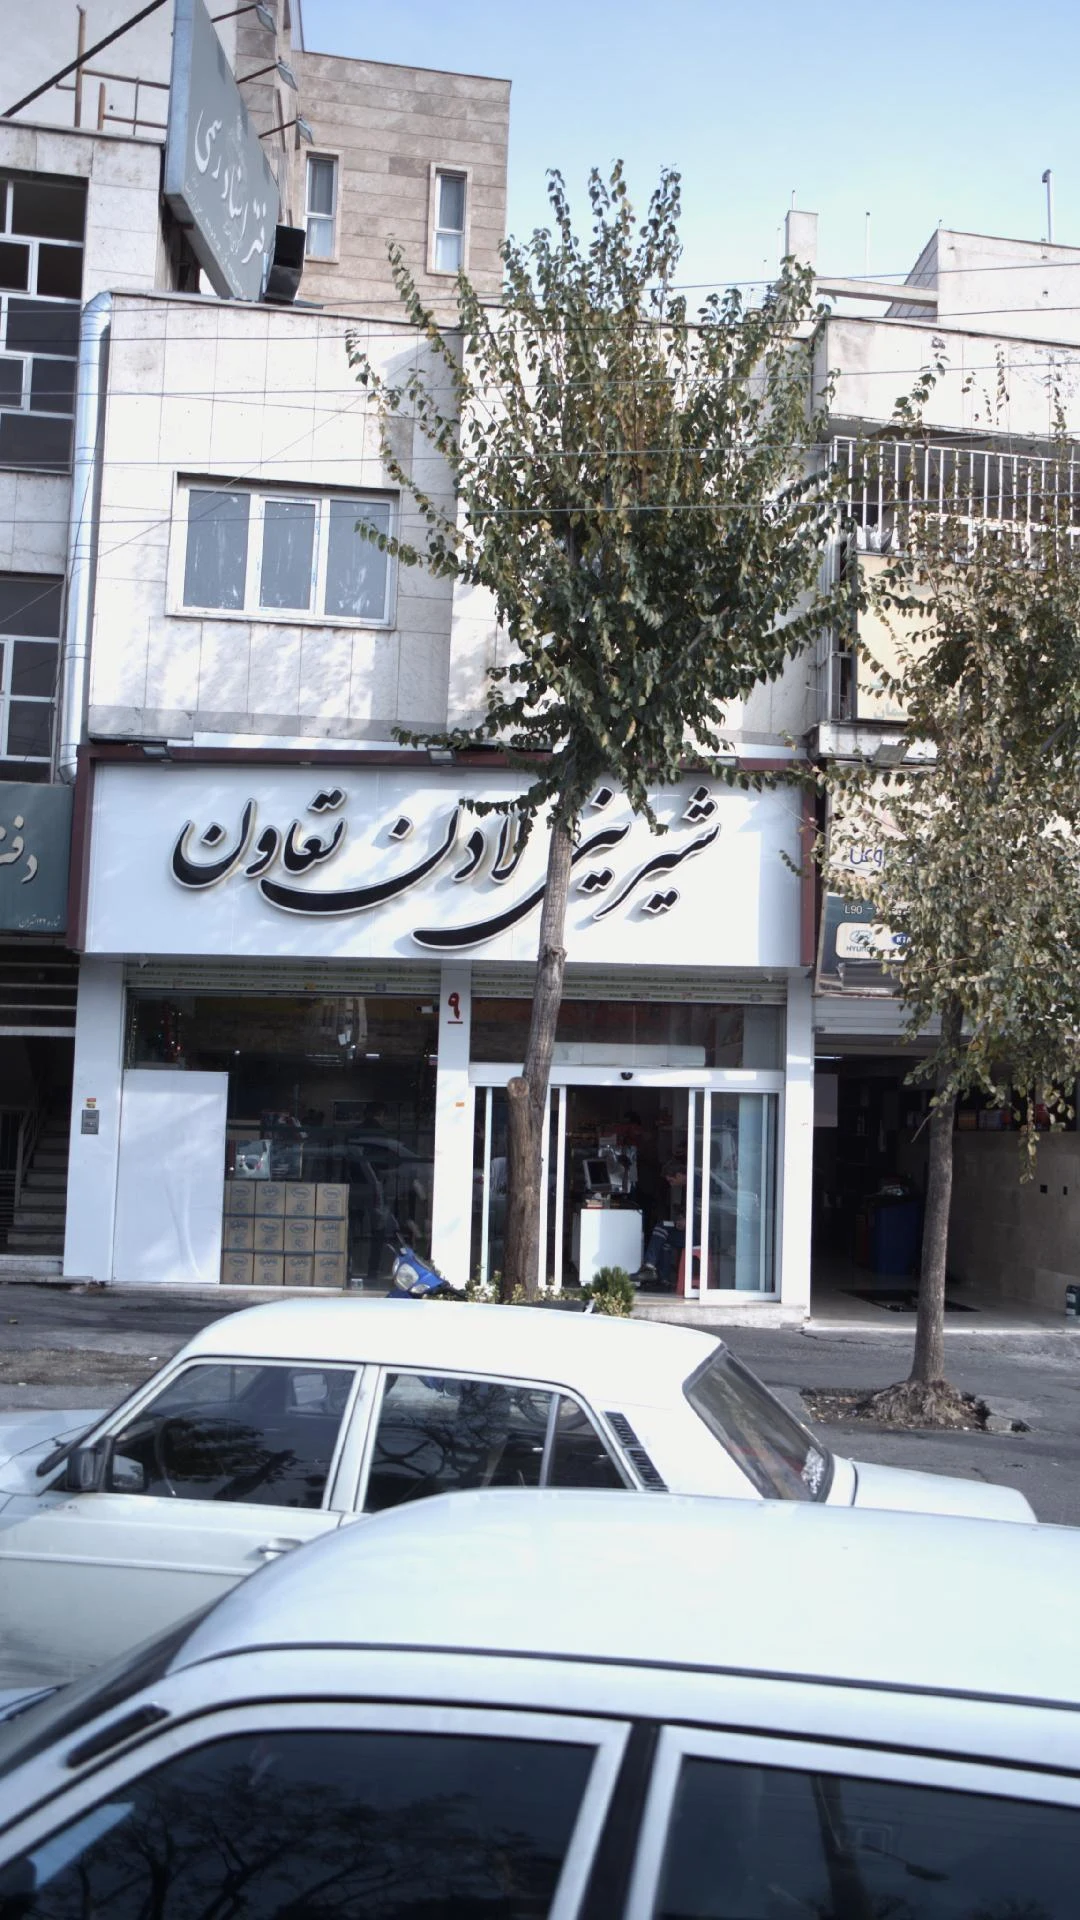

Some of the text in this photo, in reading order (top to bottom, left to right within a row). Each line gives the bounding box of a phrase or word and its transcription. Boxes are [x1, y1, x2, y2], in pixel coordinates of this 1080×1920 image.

[194, 110, 223, 179] رسمی
[241, 198, 266, 264] فتر
[171, 785, 721, 949] شیرینی لادن تعاون
[844, 905, 863, 914] L90
[448, 992, 460, 1020] ۹
